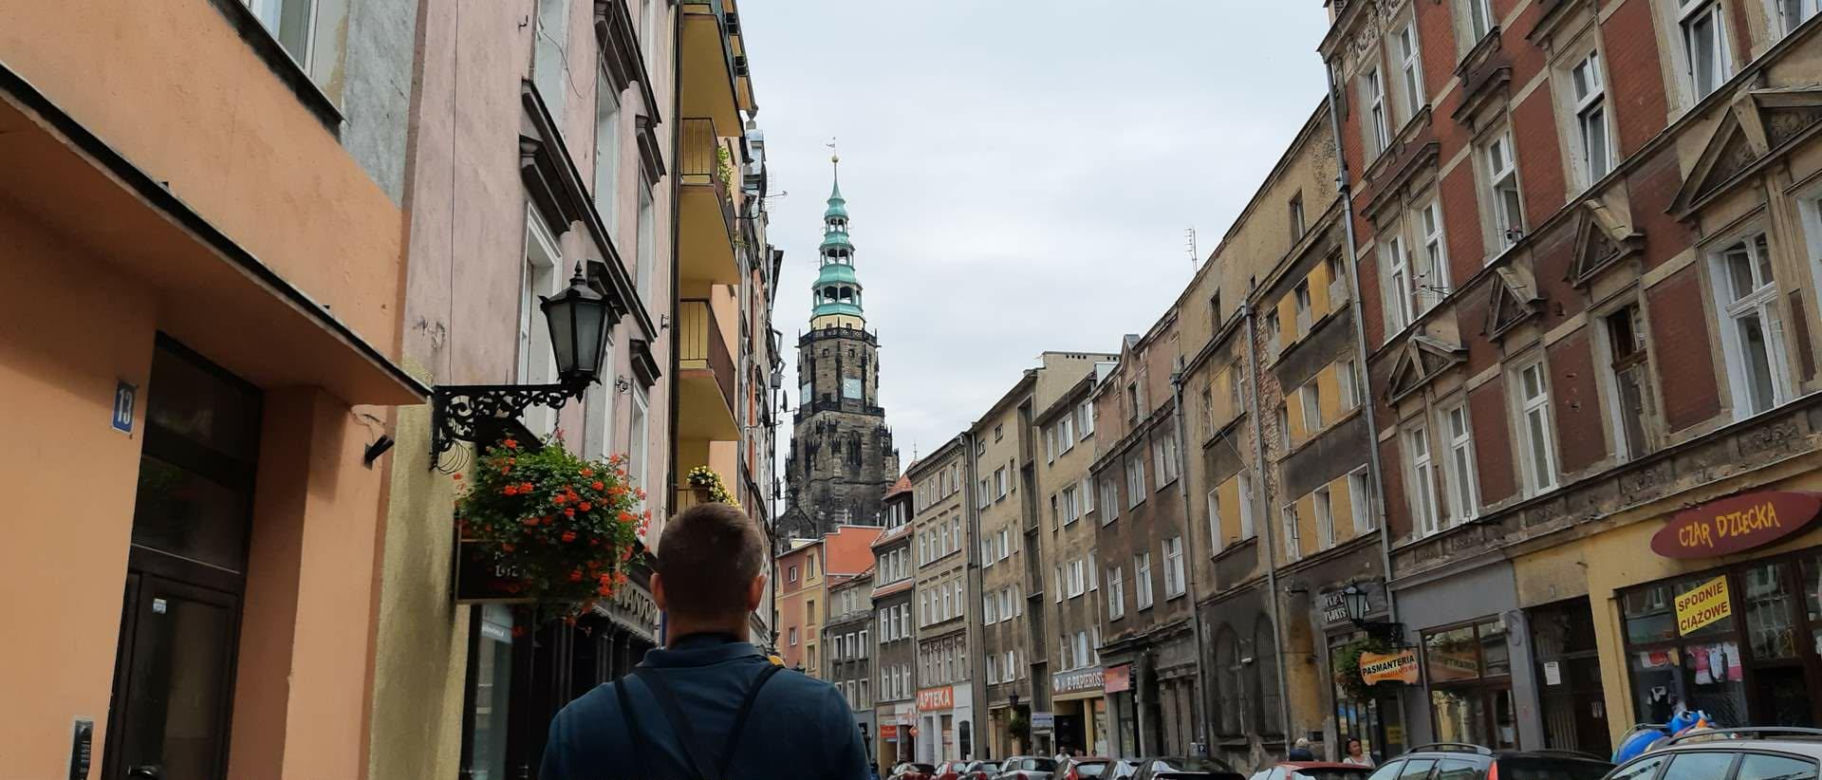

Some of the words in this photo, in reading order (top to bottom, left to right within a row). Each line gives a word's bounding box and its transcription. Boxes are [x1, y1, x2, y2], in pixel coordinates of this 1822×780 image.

[117, 388, 133, 425] 13
[1678, 521, 1714, 548] CZAR
[1677, 582, 1724, 613] SPODNIE
[1361, 655, 1415, 677] PASMANTERIA
[919, 688, 951, 709] APTEKA
